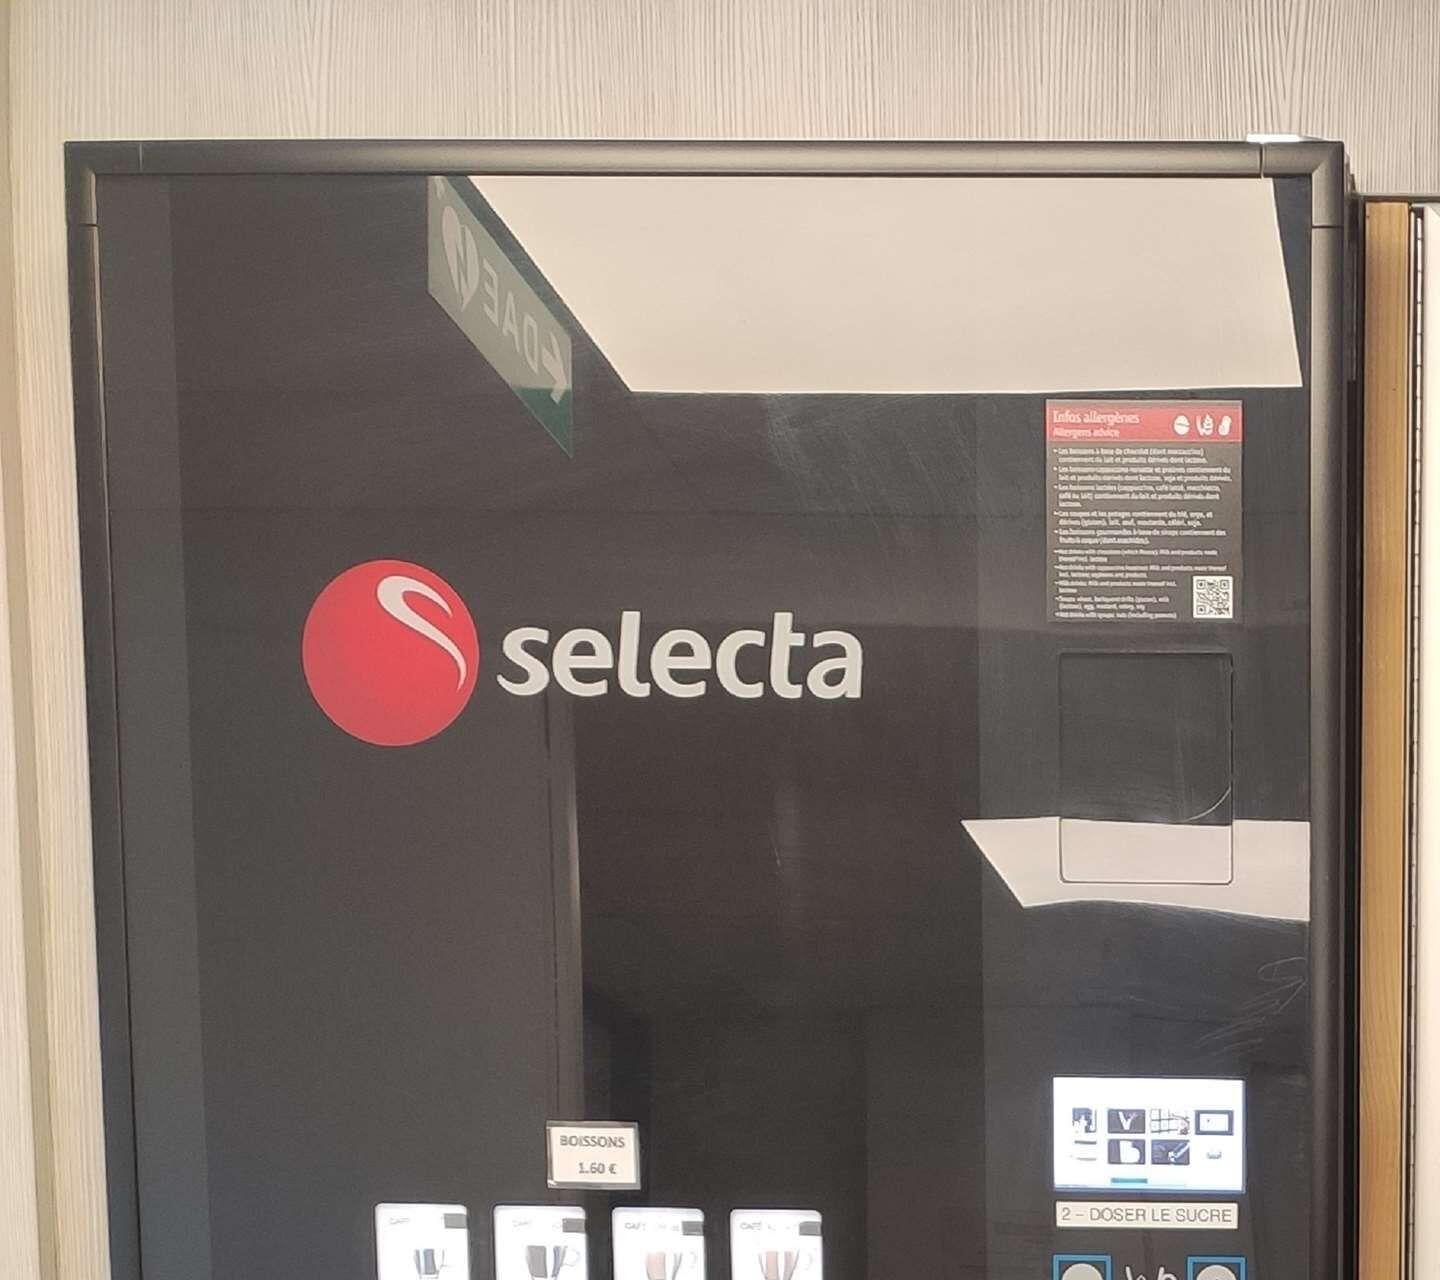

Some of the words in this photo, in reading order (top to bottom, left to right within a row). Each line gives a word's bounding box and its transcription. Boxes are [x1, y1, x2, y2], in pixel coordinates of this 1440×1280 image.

[1053, 410, 1081, 424] Infos
[497, 610, 863, 699] selecta
[560, 1135, 625, 1148] BOISSONS
[1062, 1207, 1070, 1220] 2
[1090, 1208, 1147, 1222] DOSER
[1152, 1208, 1170, 1222] LE
[1175, 1208, 1232, 1223] SUCRE
